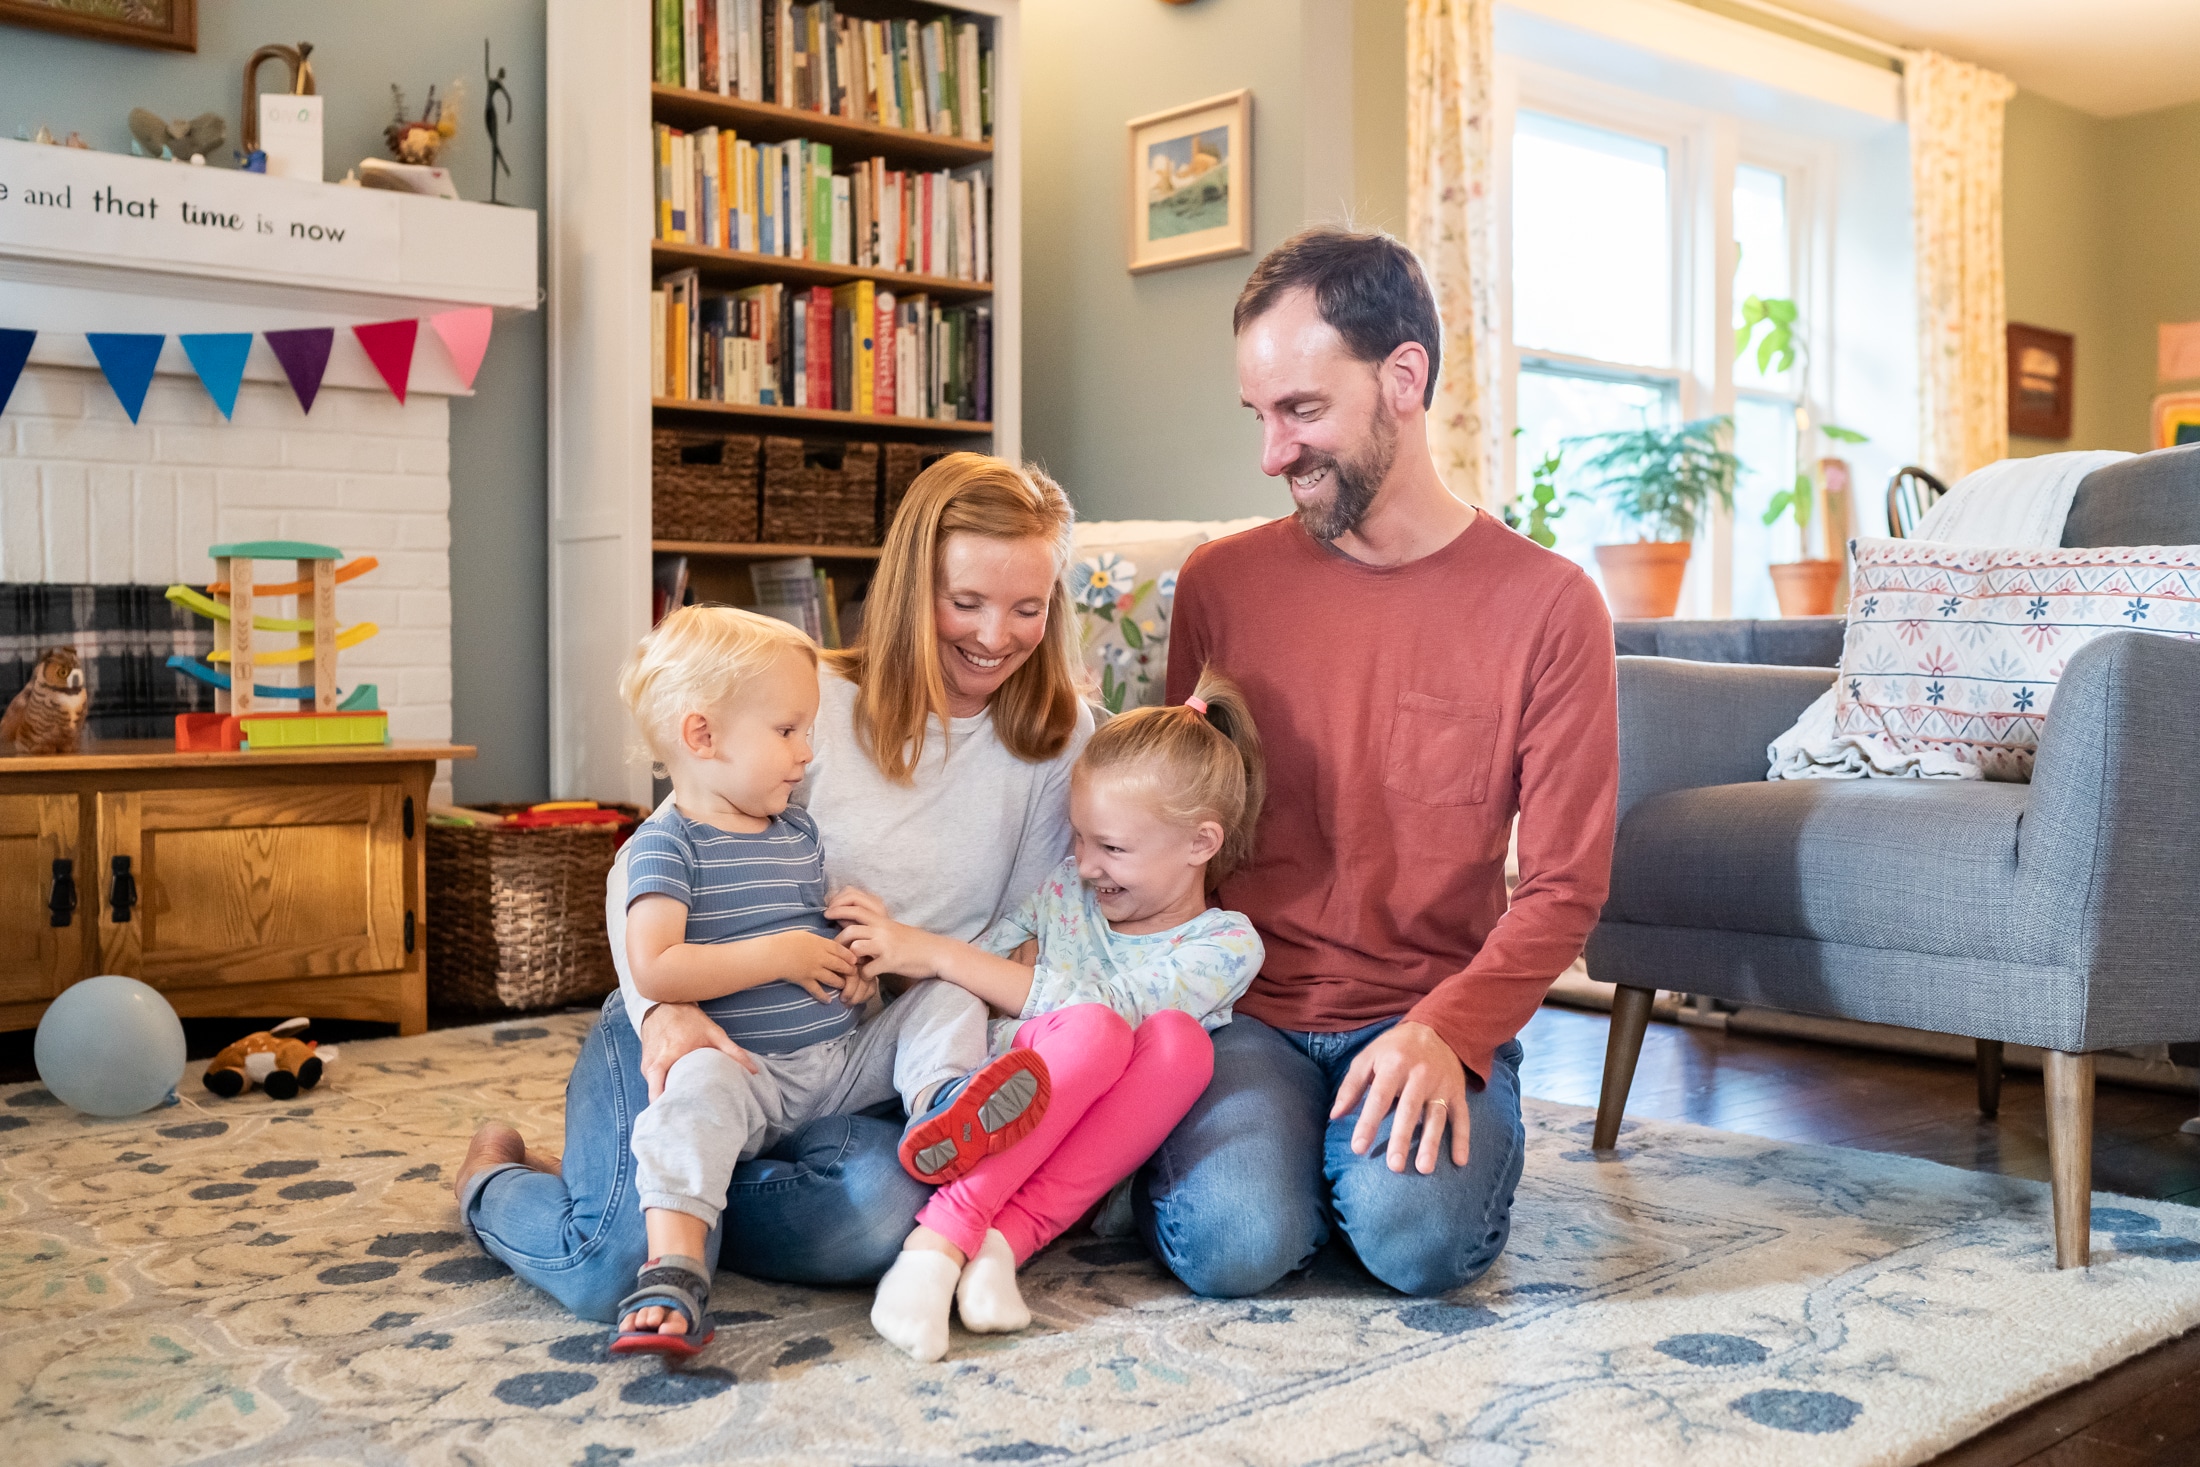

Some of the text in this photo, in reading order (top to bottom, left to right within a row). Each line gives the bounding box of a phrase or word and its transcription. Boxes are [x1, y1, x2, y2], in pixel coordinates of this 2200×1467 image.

[23, 185, 72, 210] and
[92, 185, 160, 221] that
[180, 200, 245, 232] time
[257, 213, 274, 235] is
[289, 221, 346, 245] now
